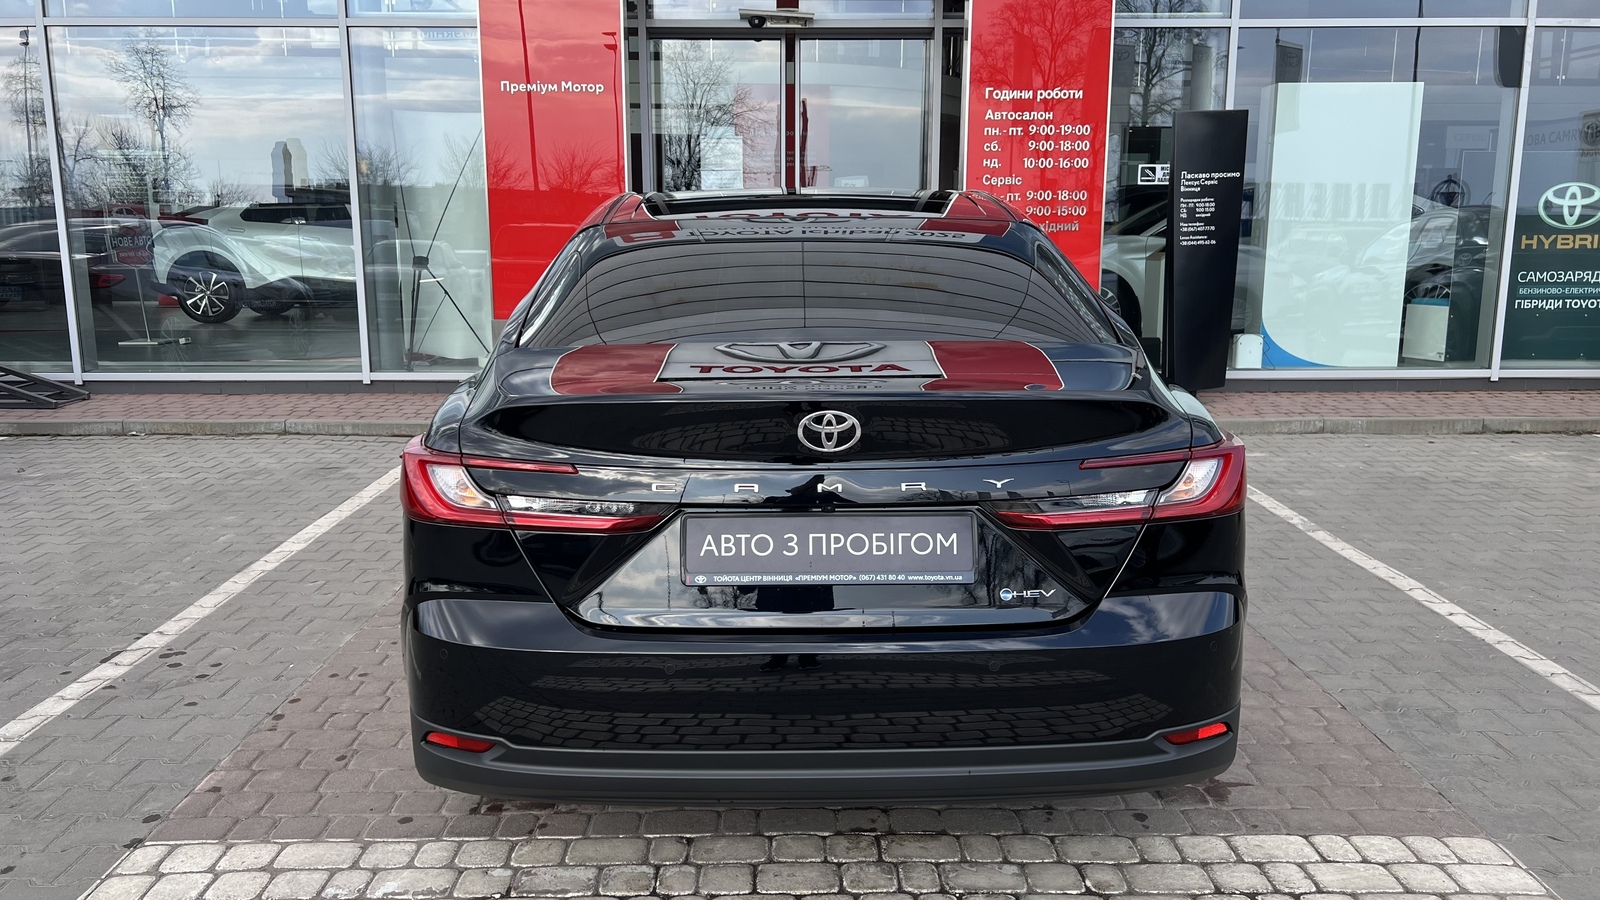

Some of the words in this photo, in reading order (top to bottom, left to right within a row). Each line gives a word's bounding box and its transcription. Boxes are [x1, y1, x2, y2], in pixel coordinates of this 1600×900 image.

[500, 80, 558, 95] Преміум
[561, 81, 605, 95] Мотор
[985, 87, 1033, 101] Години
[1036, 87, 1083, 102] роботи
[985, 109, 1053, 120] Автосалон
[1028, 124, 1091, 136] 9:00-19:00
[983, 141, 1001, 152] сб.
[1028, 140, 1090, 151] 9:00-18:00
[982, 158, 1002, 168] нд.
[1022, 157, 1089, 169] 10:00-16:00
[982, 174, 1023, 187] Сервіс
[1181, 171, 1210, 179] Ласкаво
[1211, 171, 1240, 179] просимо
[1026, 190, 1087, 201] 9:00-18:00
[1025, 205, 1087, 217] 9:00-15:00
[1038, 221, 1080, 234] хідний
[111, 235, 133, 248] НОВЕ
[1514, 298, 1563, 311] ГІБРИДИ
[690, 363, 912, 374] TOYOTA
[650, 477, 1016, 494] CAMRY
[699, 533, 774, 557] АВТО
[808, 532, 958, 556] ПРОБІГОМ
[713, 573, 740, 583] ТОЙОТА
[740, 575, 763, 583] ЦЕНТР
[763, 574, 793, 583] ВІННИЦЯ
[829, 574, 857, 582] МОТОР»
[858, 573, 876, 582] (067)
[876, 574, 887, 582] 431
[888, 574, 897, 582] 80
[897, 574, 906, 582] 40
[907, 574, 963, 582] www.toyota.vn.ua
